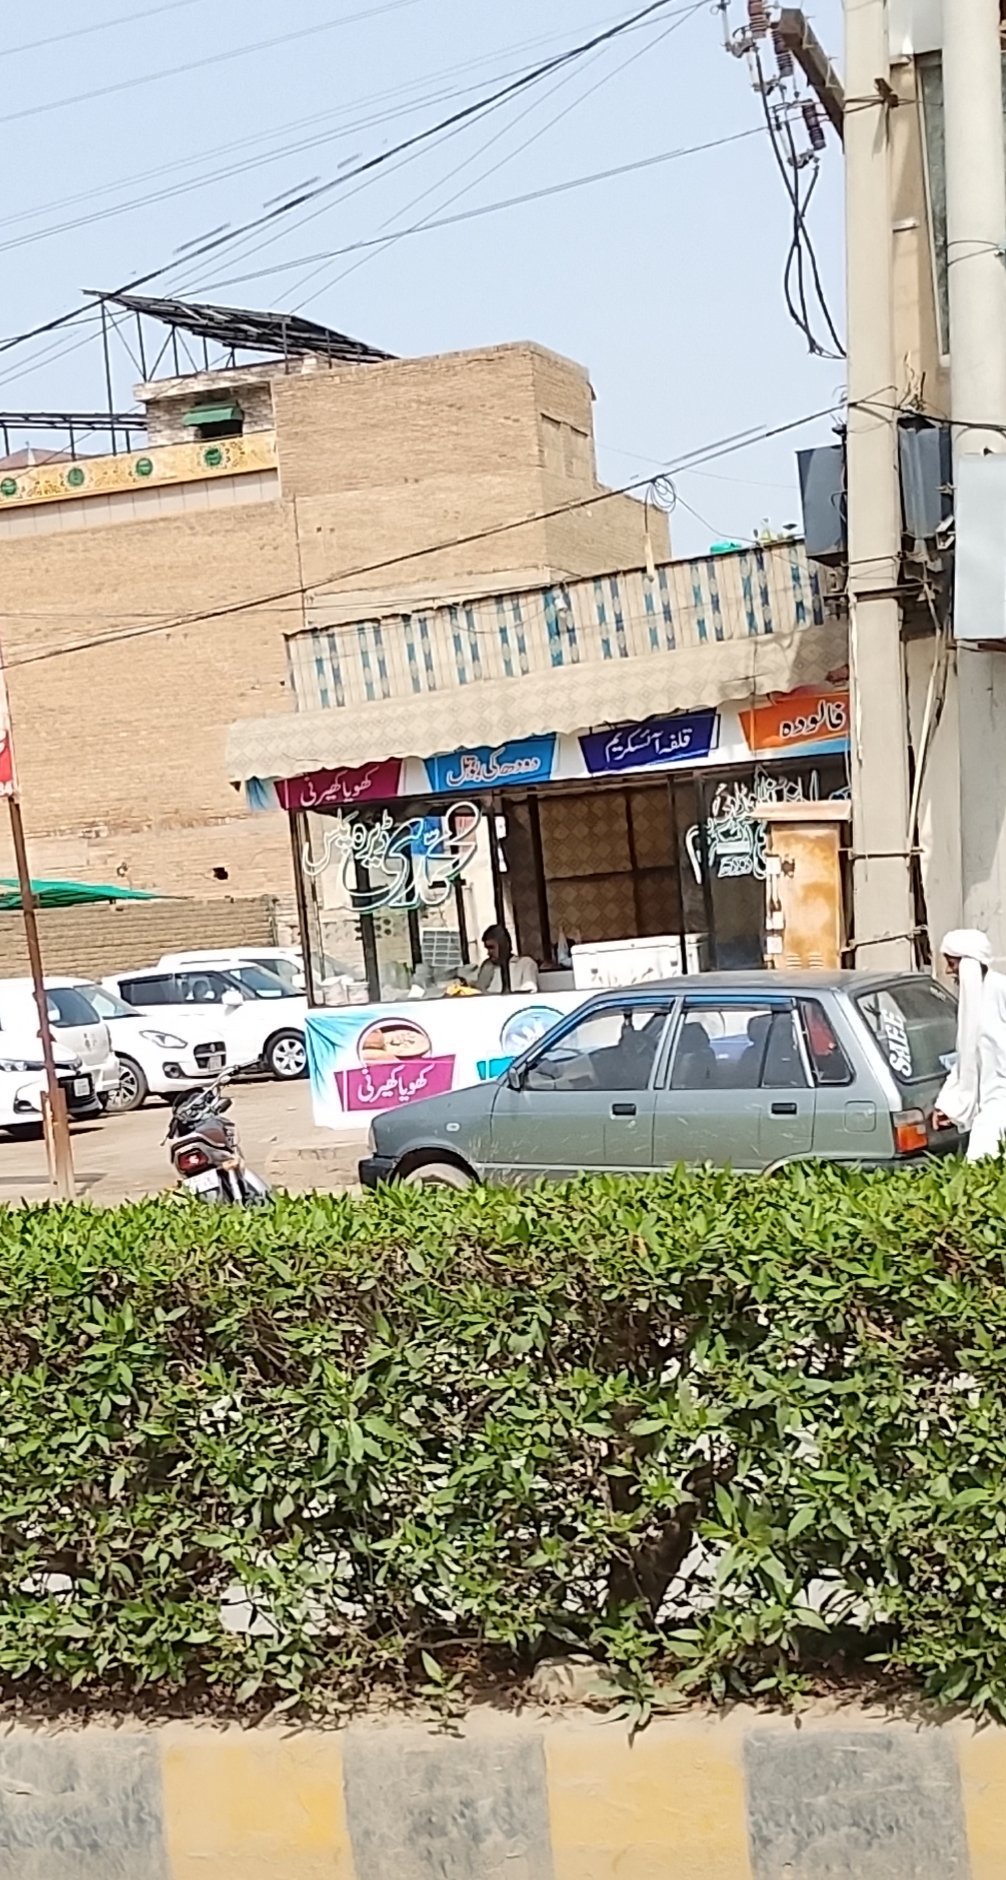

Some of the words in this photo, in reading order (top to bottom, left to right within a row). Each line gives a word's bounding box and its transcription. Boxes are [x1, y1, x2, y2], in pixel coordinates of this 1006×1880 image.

[779, 699, 846, 740] فالودہ
[446, 754, 481, 787] بوتل
[481, 745, 506, 782] کی
[499, 757, 541, 776] دودھ
[342, 765, 379, 803] کھویا
[397, 1063, 436, 1103] کھویا
